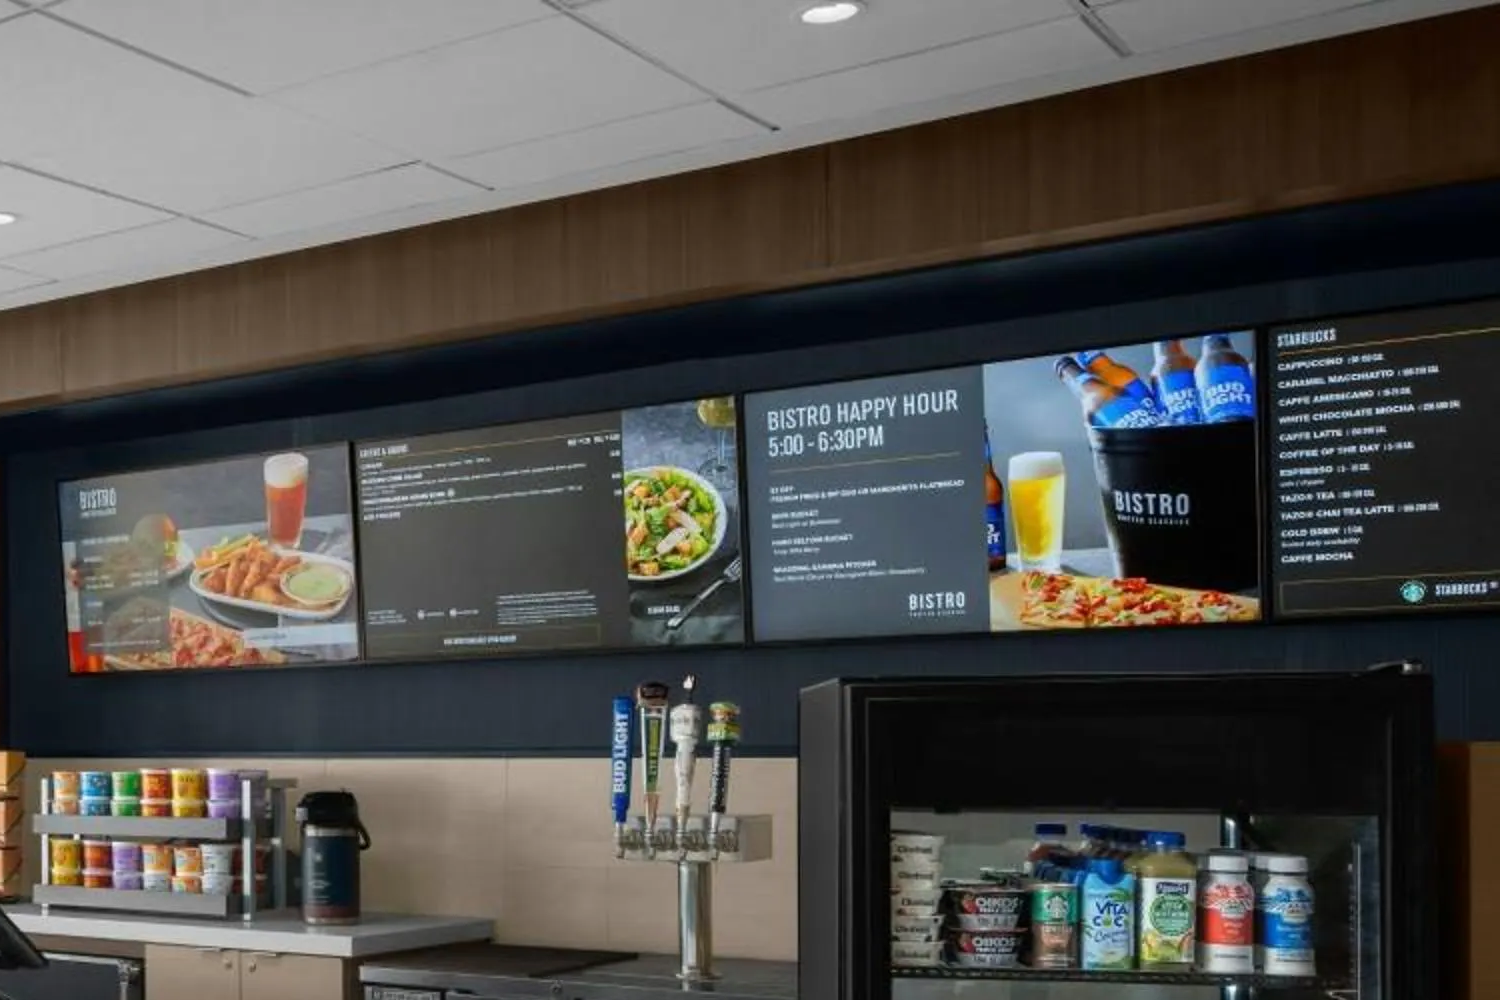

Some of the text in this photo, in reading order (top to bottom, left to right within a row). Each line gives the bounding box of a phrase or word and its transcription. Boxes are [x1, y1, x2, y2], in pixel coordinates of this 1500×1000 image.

[767, 389, 960, 431] BISTRO HAPPY HOUR
[1312, 406, 1373, 422] CHOCOLATE
[768, 433, 804, 457] 5:00
[817, 425, 884, 453] 6:30PM
[1359, 443, 1381, 453] DAY
[1114, 489, 1190, 516] BISTRO
[1364, 505, 1395, 516] LATTE
[909, 591, 965, 610] BISTRO
[612, 713, 629, 793] BUD LIGHT
[1095, 901, 1129, 915] VITA
